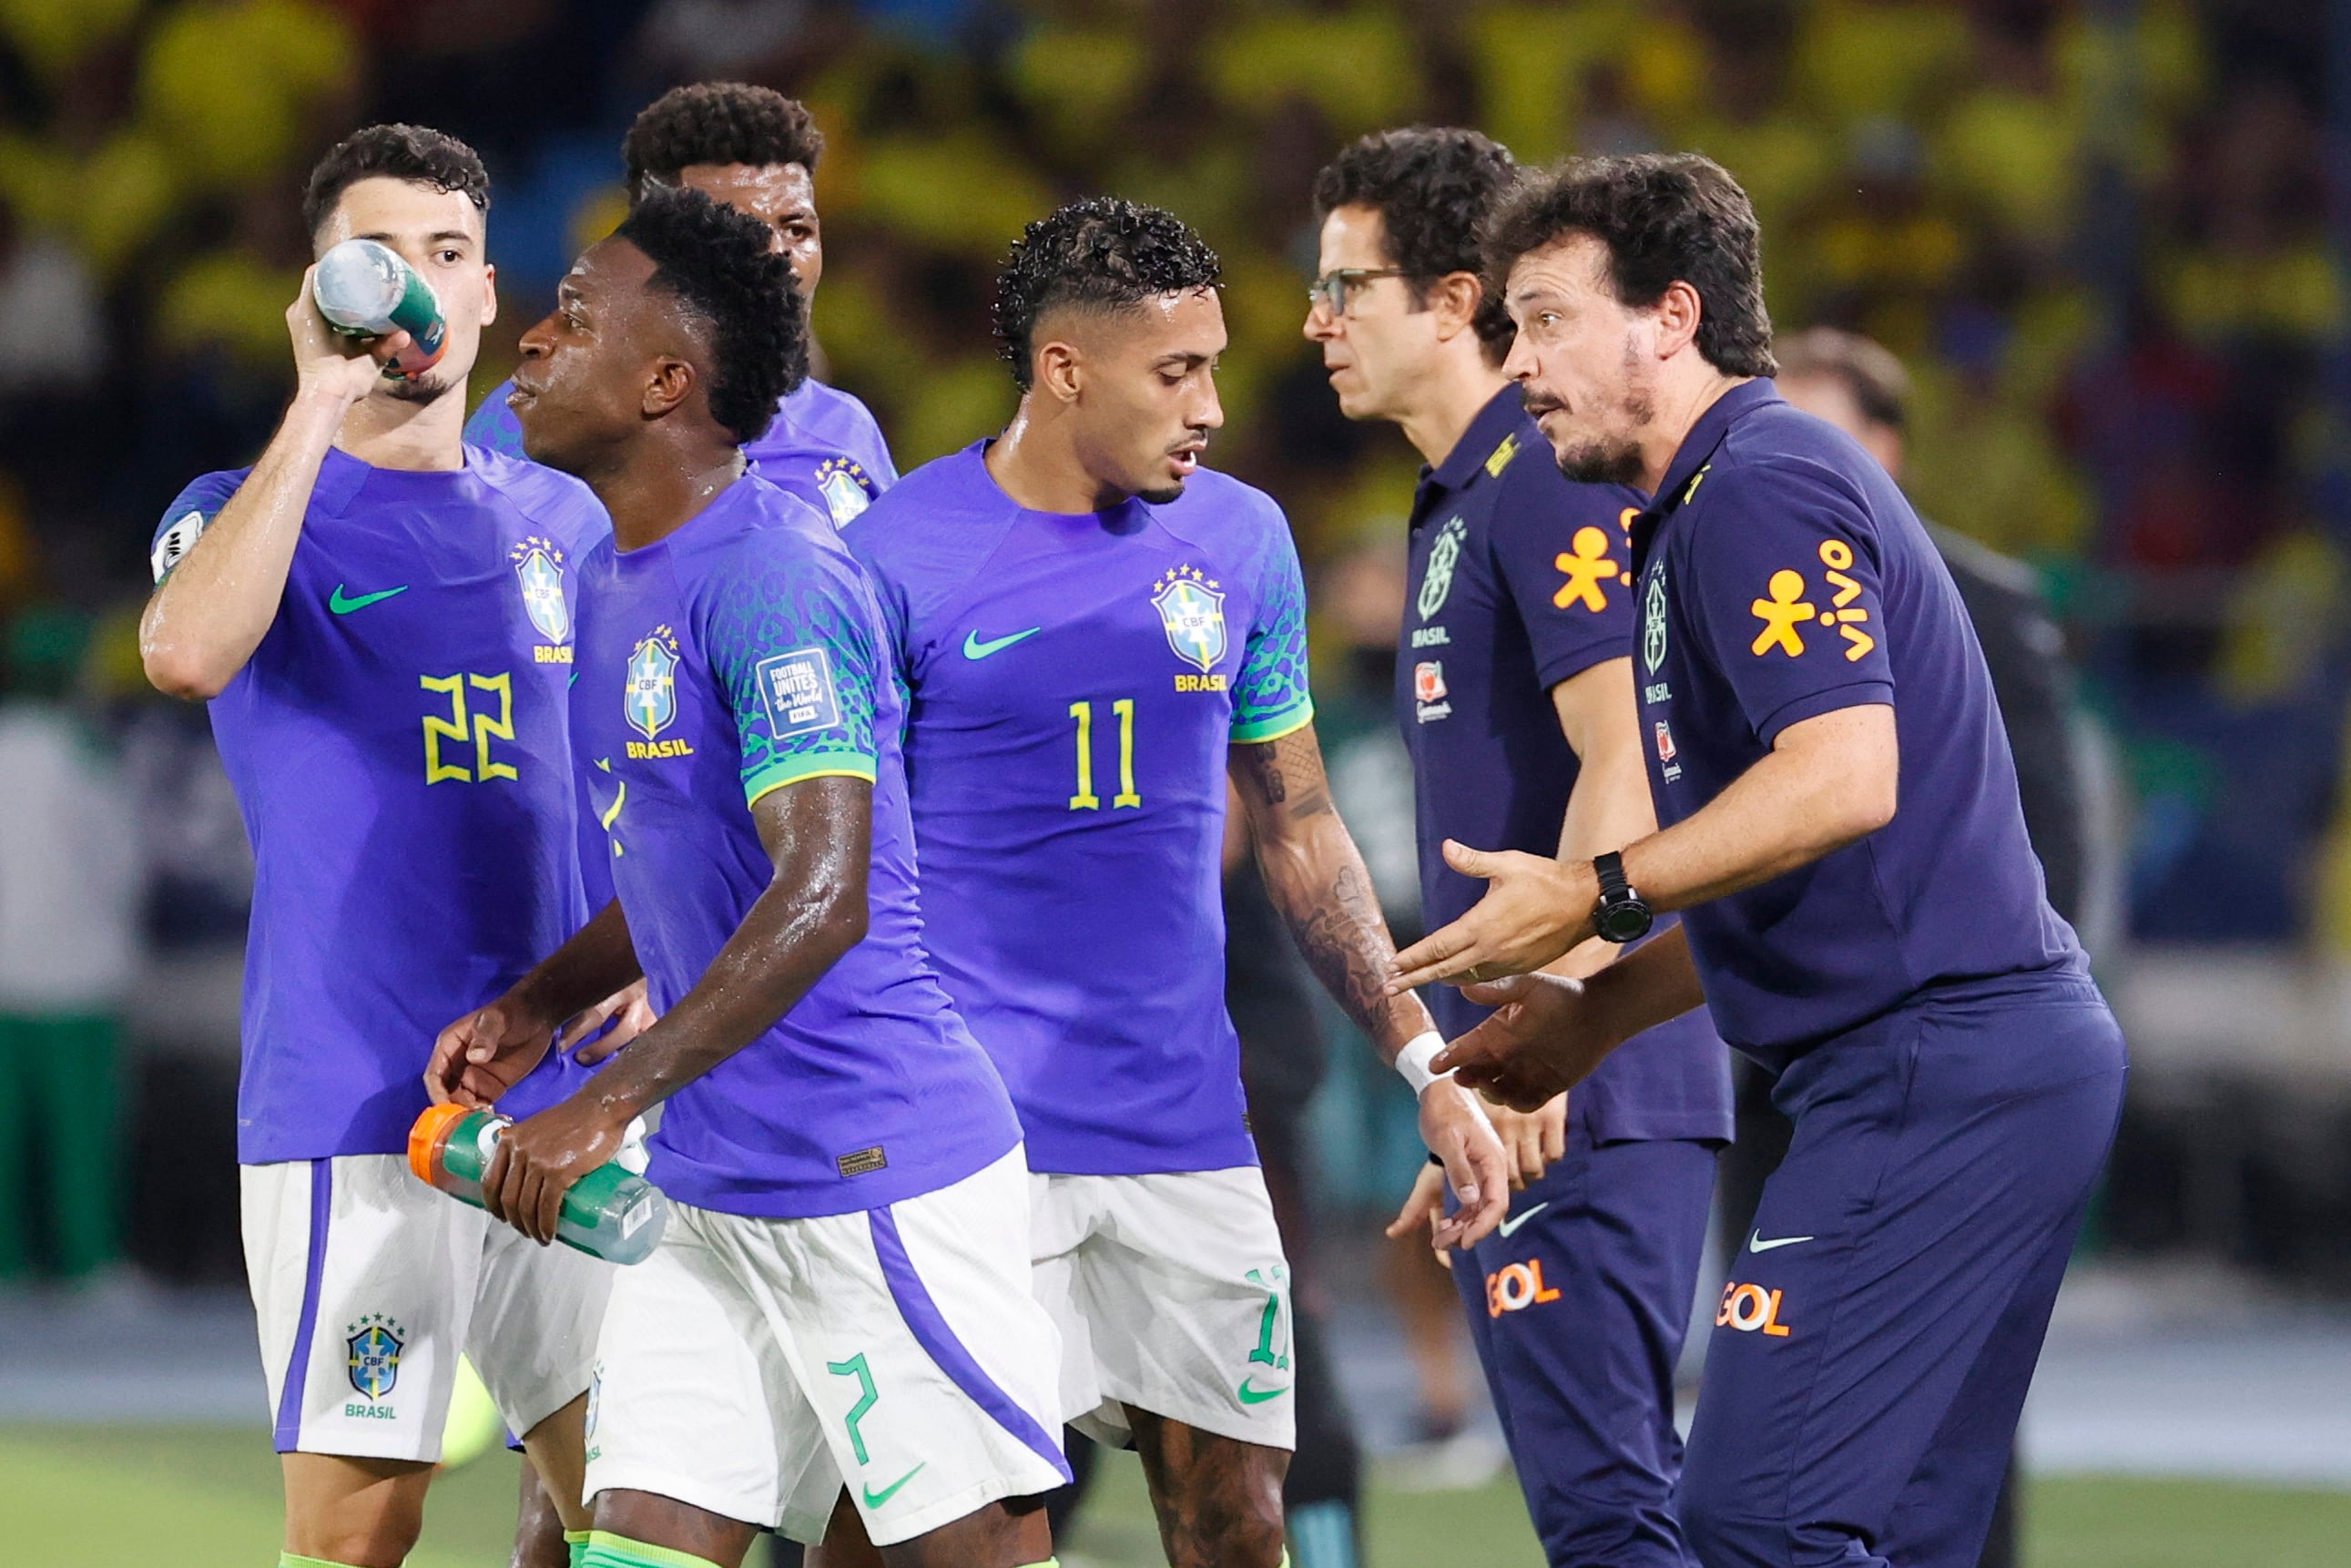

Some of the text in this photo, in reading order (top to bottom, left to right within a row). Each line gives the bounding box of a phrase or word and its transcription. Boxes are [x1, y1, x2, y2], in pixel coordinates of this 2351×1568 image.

[1818, 539, 1875, 663] vivo
[1182, 616, 1205, 627] CBF
[769, 660, 816, 682] FOOTBALL
[639, 678, 657, 690] CBF
[773, 673, 819, 698] UNITES
[1174, 674, 1227, 692] BRASIL
[420, 671, 519, 786] 22
[626, 738, 694, 759] BRASIL
[1069, 698, 1142, 811] 11
[1486, 1258, 1562, 1319] GOL
[1715, 1281, 1790, 1338] GOL
[363, 1356, 384, 1367] CBF
[344, 1403, 397, 1420] BRASIL
[827, 1352, 879, 1467] 7
